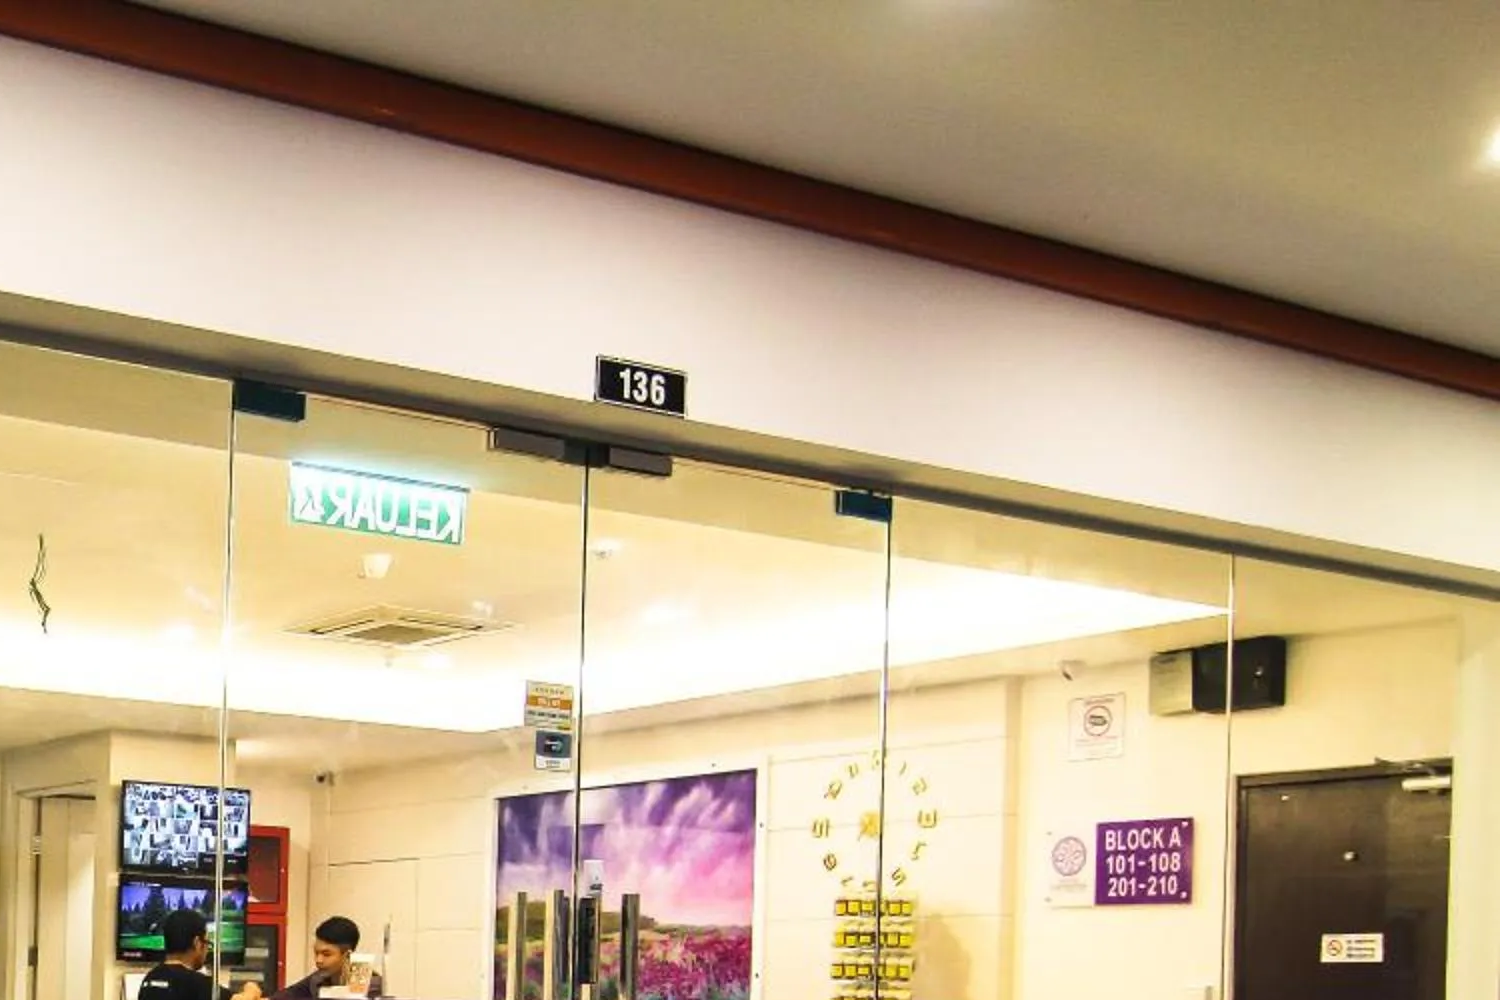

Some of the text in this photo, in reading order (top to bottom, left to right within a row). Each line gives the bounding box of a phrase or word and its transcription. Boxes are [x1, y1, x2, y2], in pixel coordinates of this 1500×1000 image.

[618, 367, 666, 406] 136
[1104, 825, 1182, 851] BLOCK A
[1106, 851, 1181, 875] 101-108
[1107, 874, 1178, 897] 201-210
